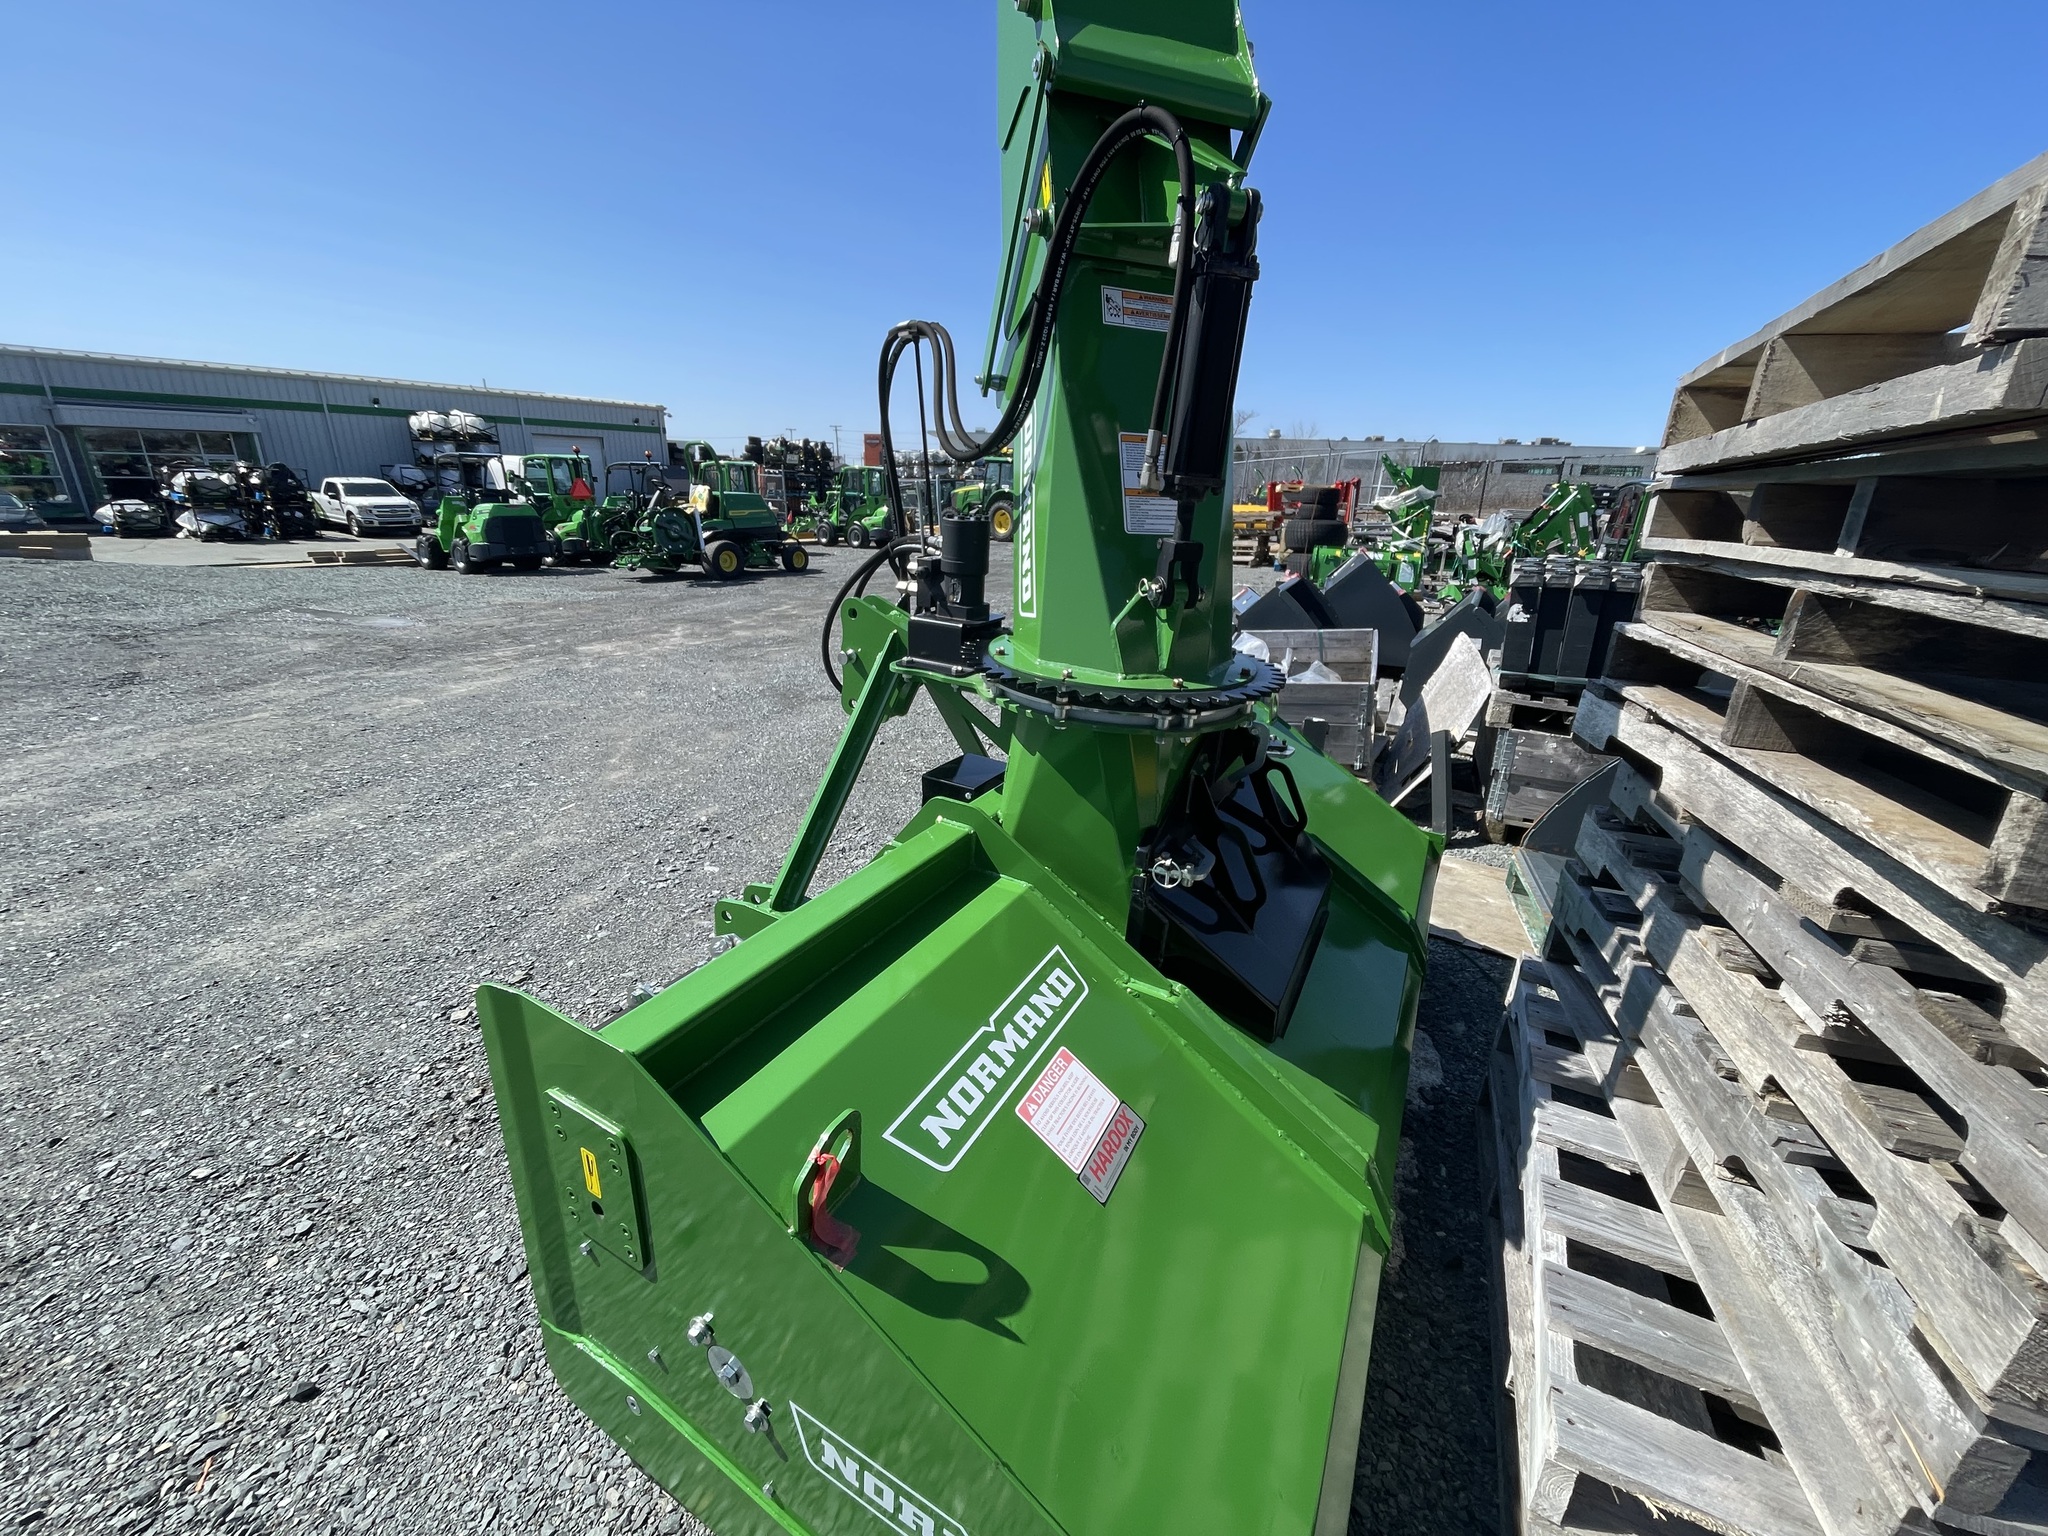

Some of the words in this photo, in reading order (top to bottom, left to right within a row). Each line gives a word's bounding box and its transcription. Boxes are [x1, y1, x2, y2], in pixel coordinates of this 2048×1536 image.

[1051, 279, 1060, 293] BAR
[1144, 295, 1169, 303] WARNING
[1035, 351, 1044, 369] MSHA
[1022, 411, 1034, 604] ORMAND
[920, 967, 1076, 1150] NORMAND
[1033, 1057, 1069, 1104] DANGER
[1089, 1108, 1135, 1184] HARDOX
[1123, 1144, 1129, 1152] IN
[1126, 1137, 1133, 1146] MY
[1130, 1124, 1140, 1139] BODY
[821, 1437, 952, 1536] NOR
